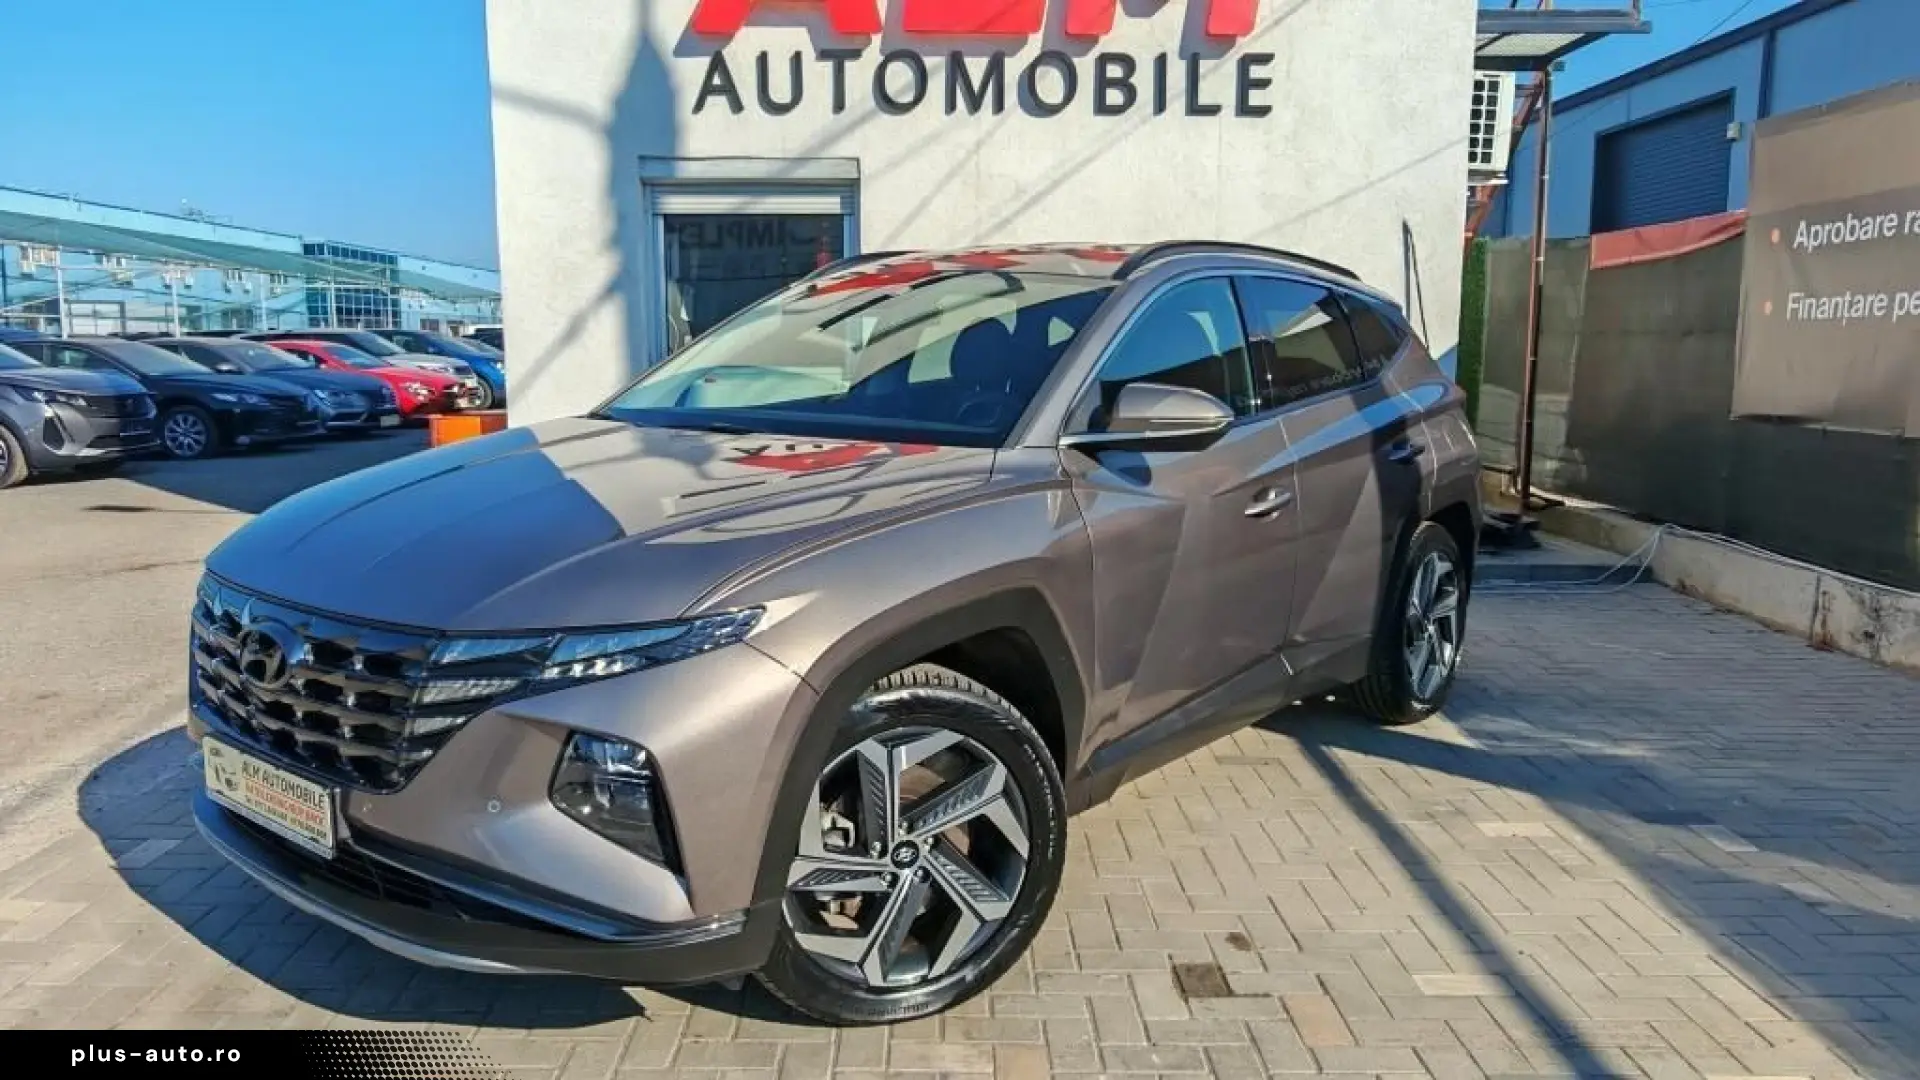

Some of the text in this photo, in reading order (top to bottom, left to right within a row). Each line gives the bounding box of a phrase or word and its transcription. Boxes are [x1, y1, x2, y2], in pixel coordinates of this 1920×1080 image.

[692, 49, 1275, 117] AUTOMOBILE
[1792, 212, 1898, 253] Aprobare
[1786, 291, 1889, 327] Finanțare
[262, 769, 325, 808] AUTOMOBILE
